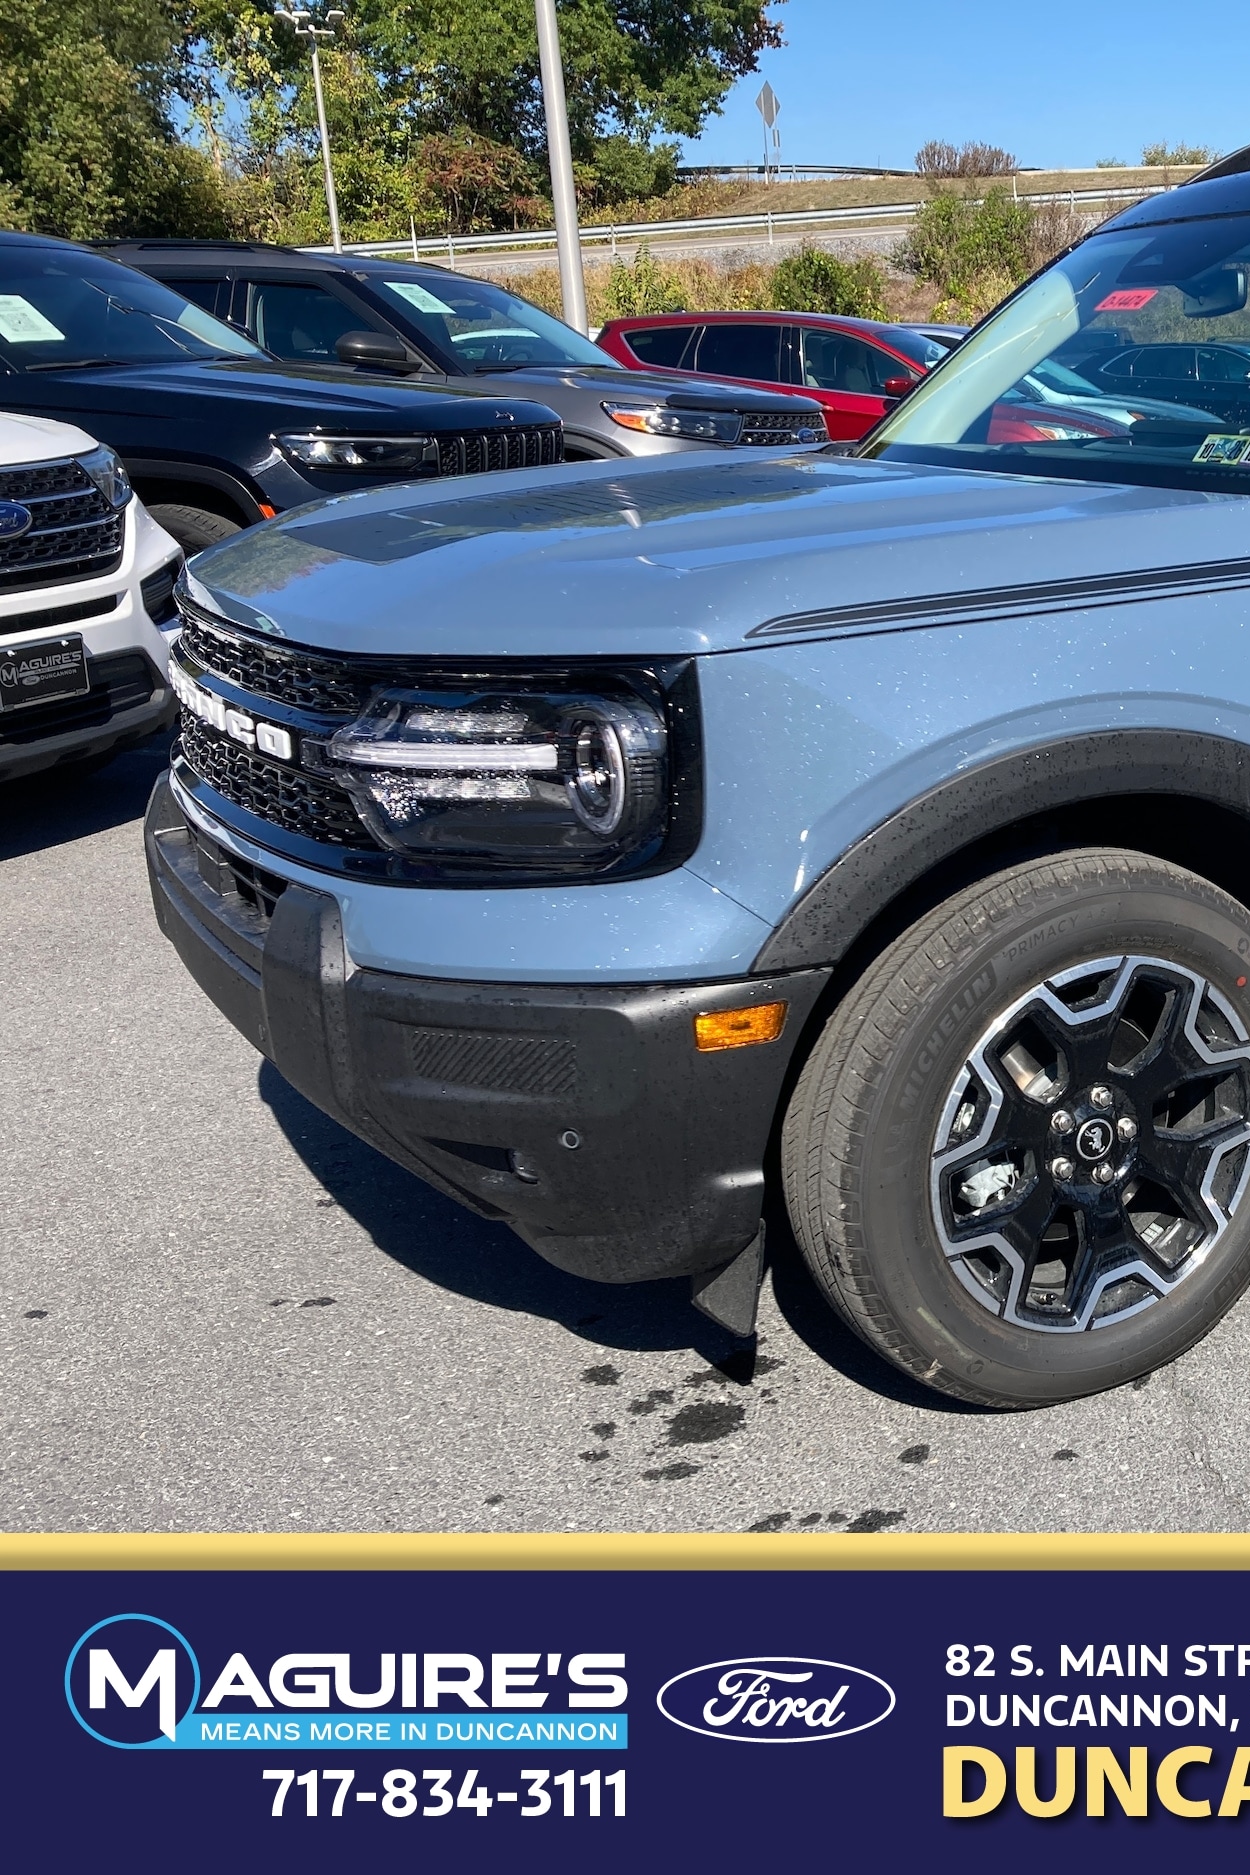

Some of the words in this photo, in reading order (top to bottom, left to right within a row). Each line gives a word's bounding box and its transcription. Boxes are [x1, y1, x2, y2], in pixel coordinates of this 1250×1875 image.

[1199, 442, 1216, 459] 10
[40, 669, 77, 681] DUNCANNON
[1007, 916, 1078, 962] PRIMACY
[900, 970, 995, 1112] MICHELIN
